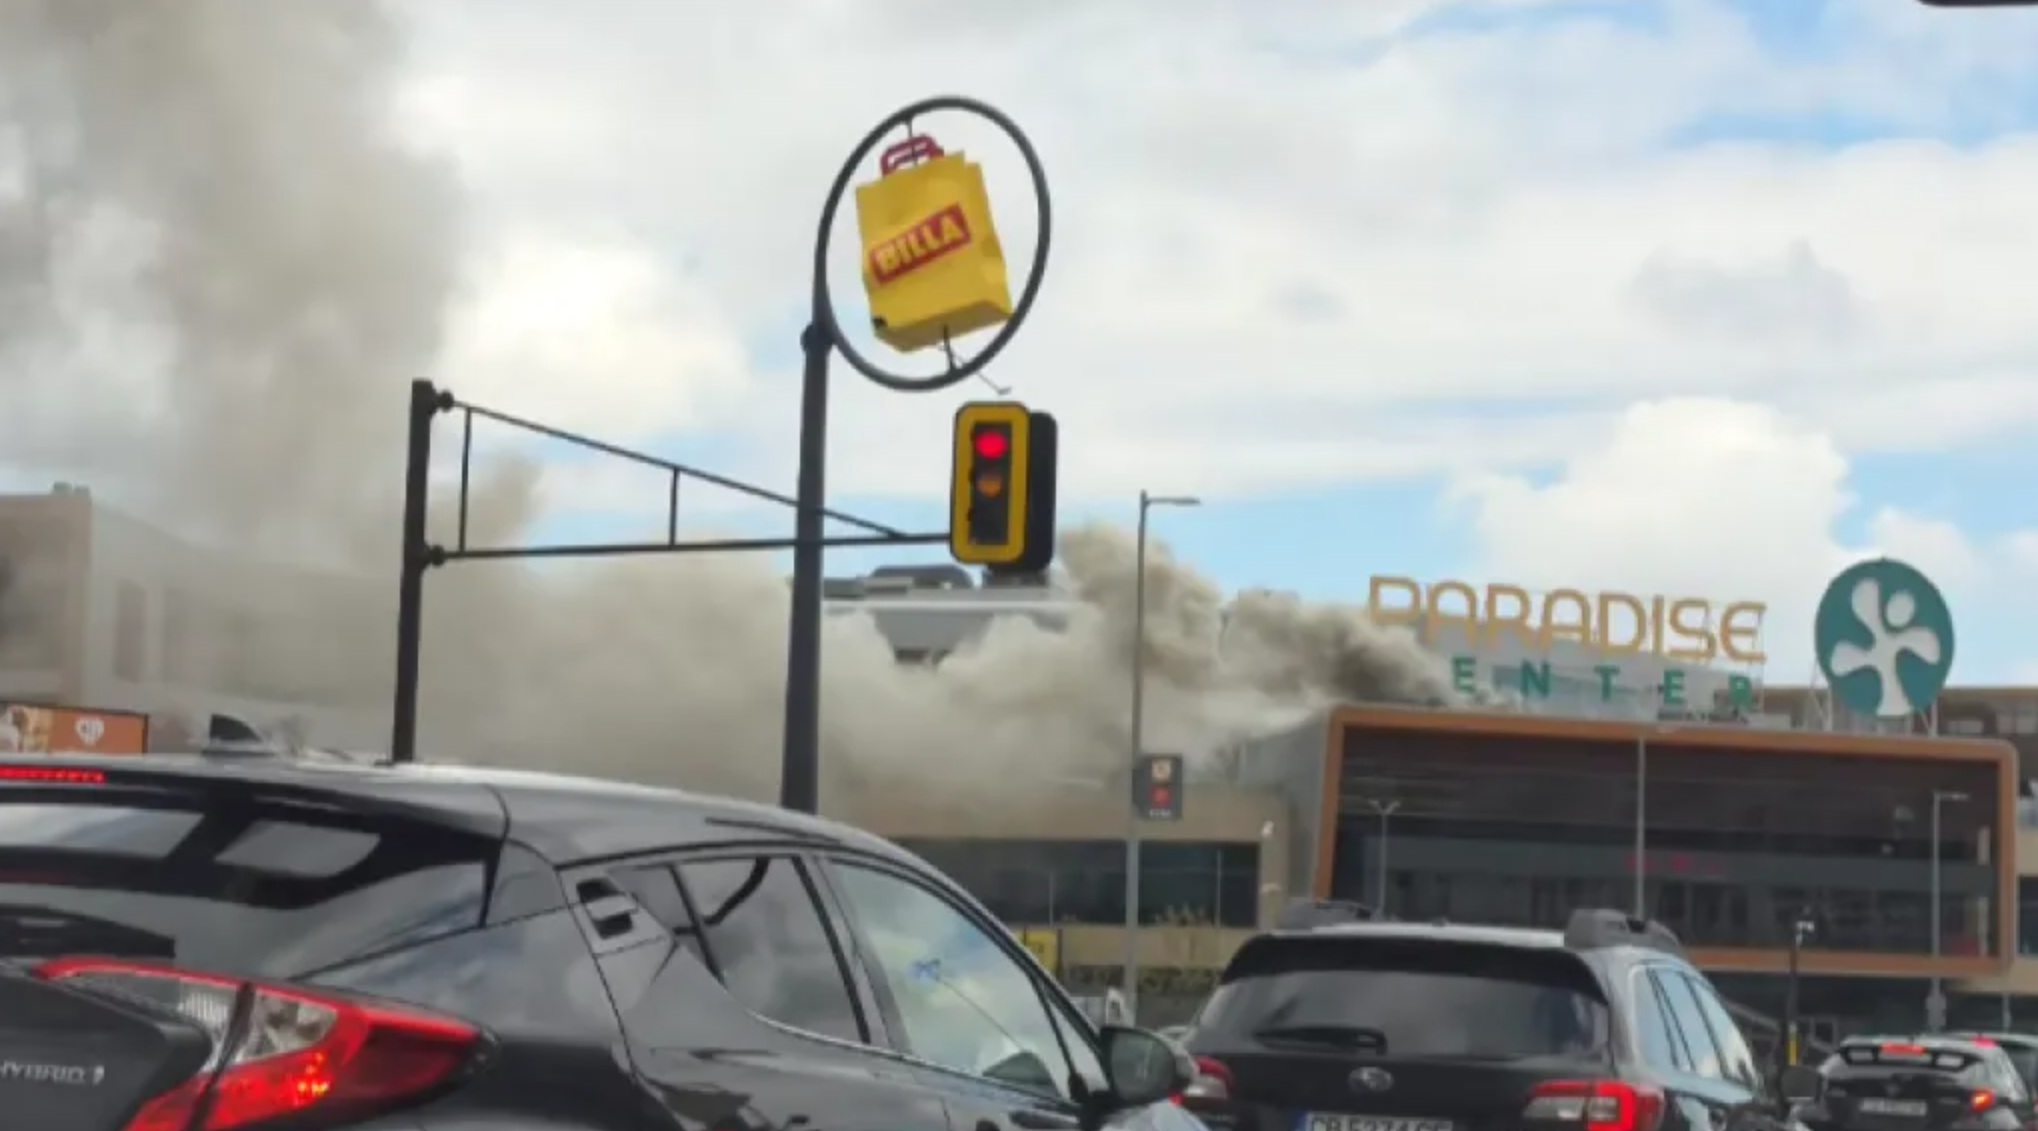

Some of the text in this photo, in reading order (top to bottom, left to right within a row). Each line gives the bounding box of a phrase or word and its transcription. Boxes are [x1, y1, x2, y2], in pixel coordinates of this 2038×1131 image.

[875, 212, 965, 272] BILLA
[1369, 575, 1768, 664] PARADISE
[1451, 656, 1753, 710] ENTER
